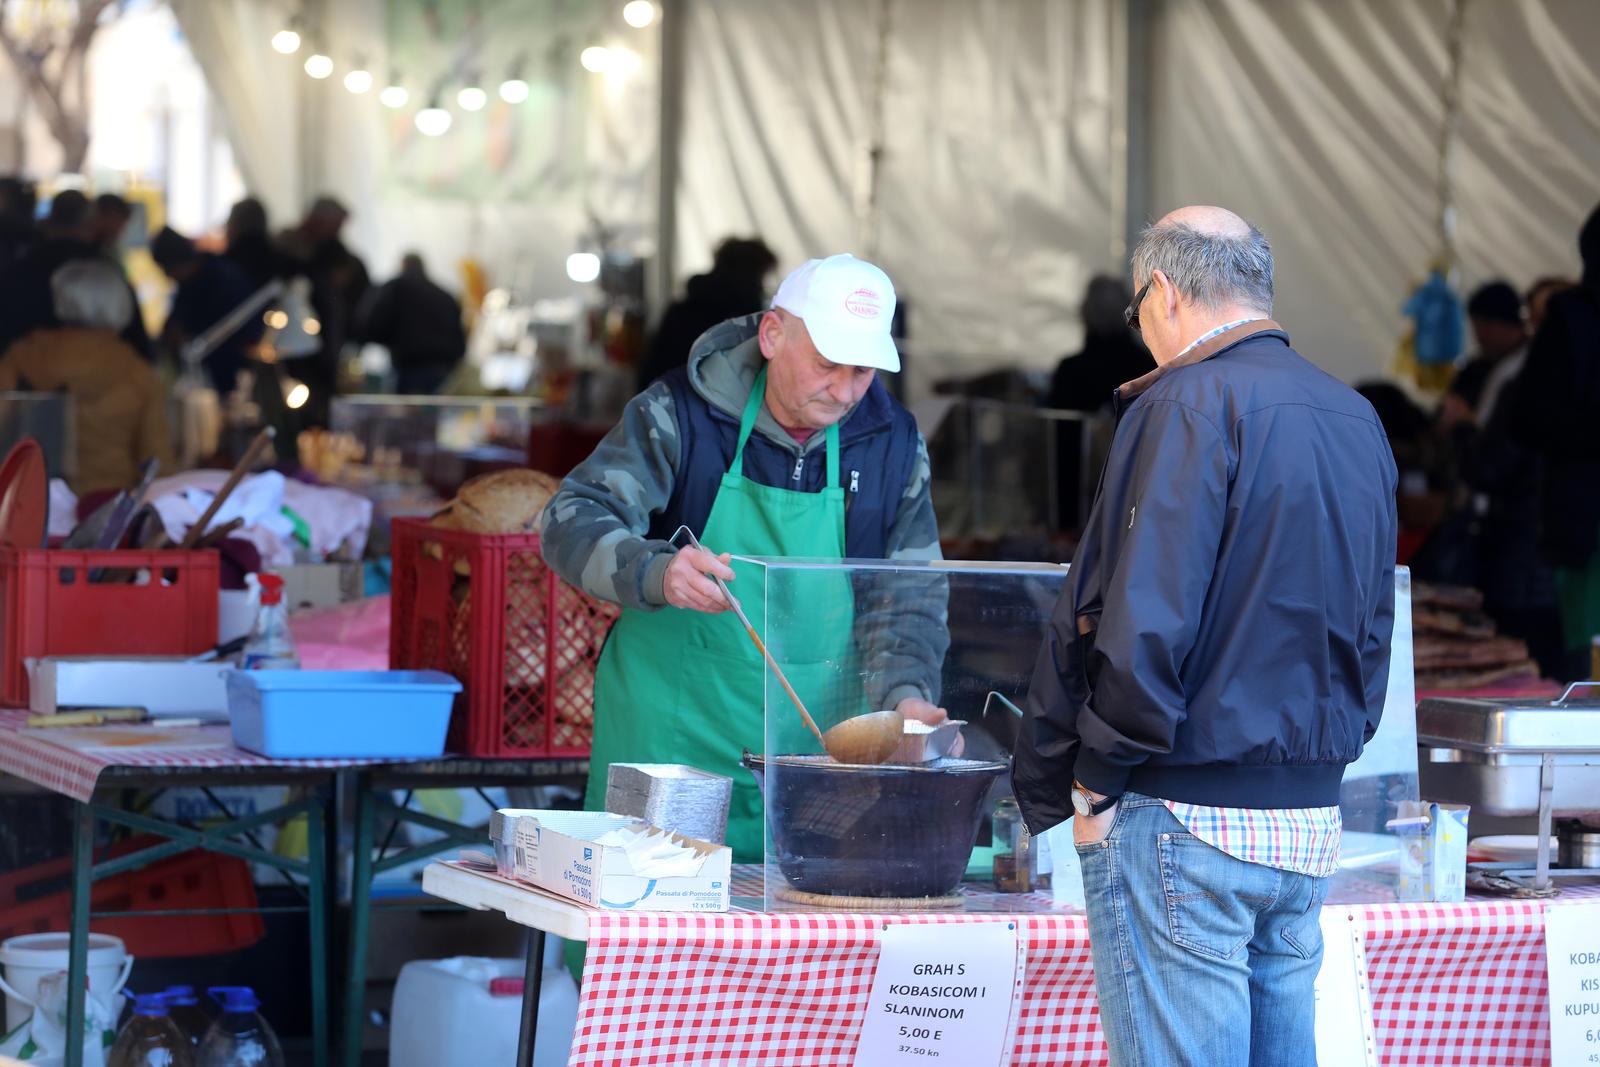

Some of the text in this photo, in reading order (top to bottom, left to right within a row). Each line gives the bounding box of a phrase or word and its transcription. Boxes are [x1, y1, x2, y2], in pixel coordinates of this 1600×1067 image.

[574, 860, 592, 875] Passata
[569, 870, 592, 887] Pomodoro
[913, 964, 966, 976] GRAH S
[889, 984, 986, 998] KOBASICOM I
[1581, 978, 1600, 991] KIS
[884, 1003, 965, 1019] SLANINOM
[1565, 1003, 1600, 1016] KUPU
[898, 1026, 943, 1040] 5,00 E
[898, 1045, 940, 1057] 37.50 kn
